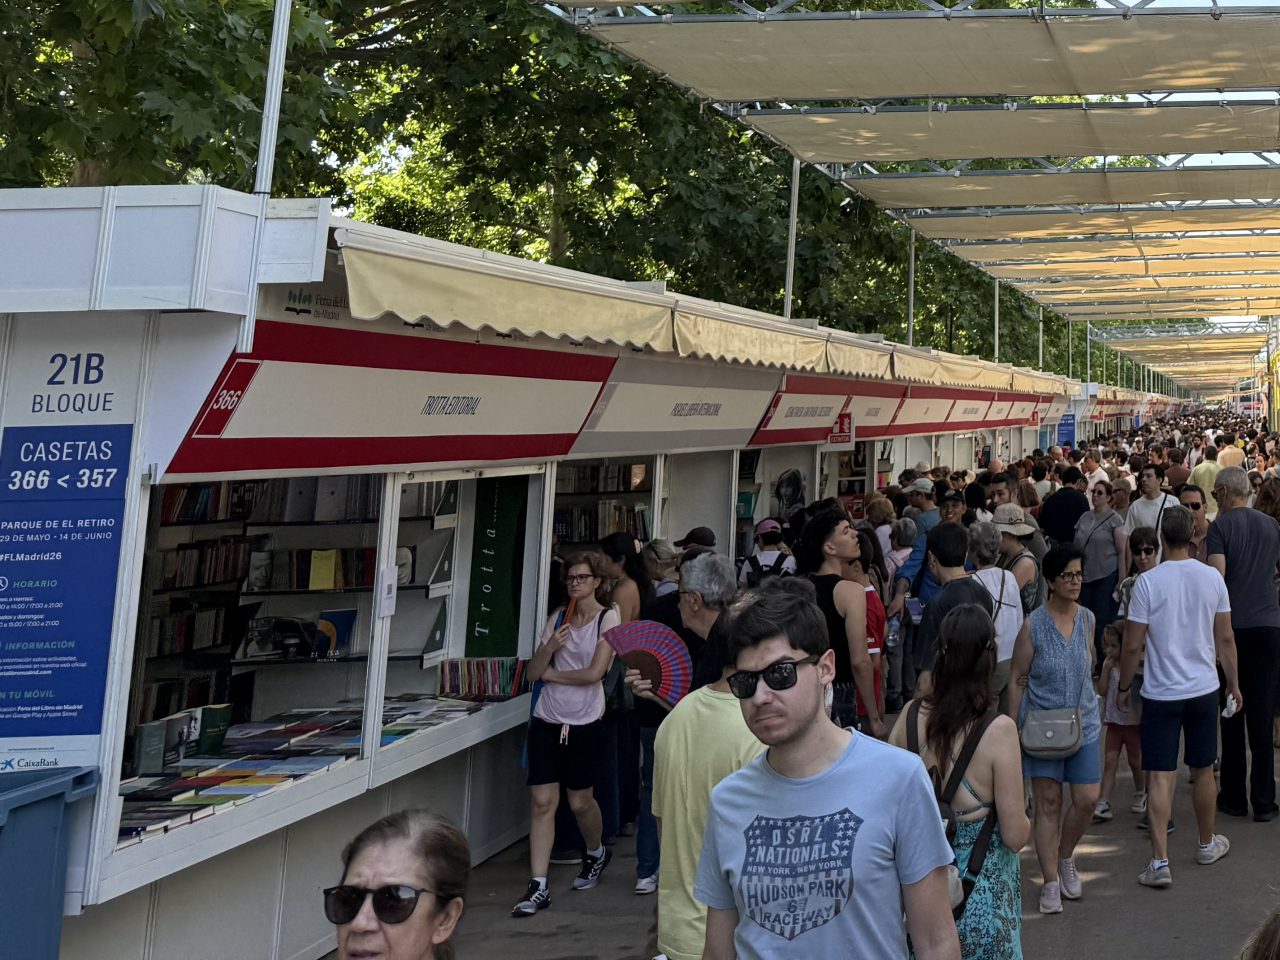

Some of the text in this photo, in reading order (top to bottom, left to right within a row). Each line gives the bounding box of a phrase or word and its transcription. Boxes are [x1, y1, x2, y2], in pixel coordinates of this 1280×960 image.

[47, 353, 105, 386] 21B
[32, 392, 114, 414] BLOQUE
[213, 389, 242, 410] 366
[20, 440, 113, 462] CASETAS
[8, 469, 51, 491] 366
[76, 468, 118, 489] 357
[1, 518, 115, 529] PARQUE DE EL RETIRO
[12, 534, 25, 542] DE
[85, 532, 112, 540] JUNIO
[13, 580, 58, 588] HORARIO
[5, 640, 75, 650] INFORMACIÓN
[17, 758, 59, 768] CaixaBank
[756, 839, 841, 865] NATIONALS
[746, 865, 766, 873] NEW
[797, 864, 817, 873] NEW
[818, 859, 843, 870] YORK
[746, 879, 847, 909] HUDSON PARK
[763, 905, 834, 926] RACEWAY
